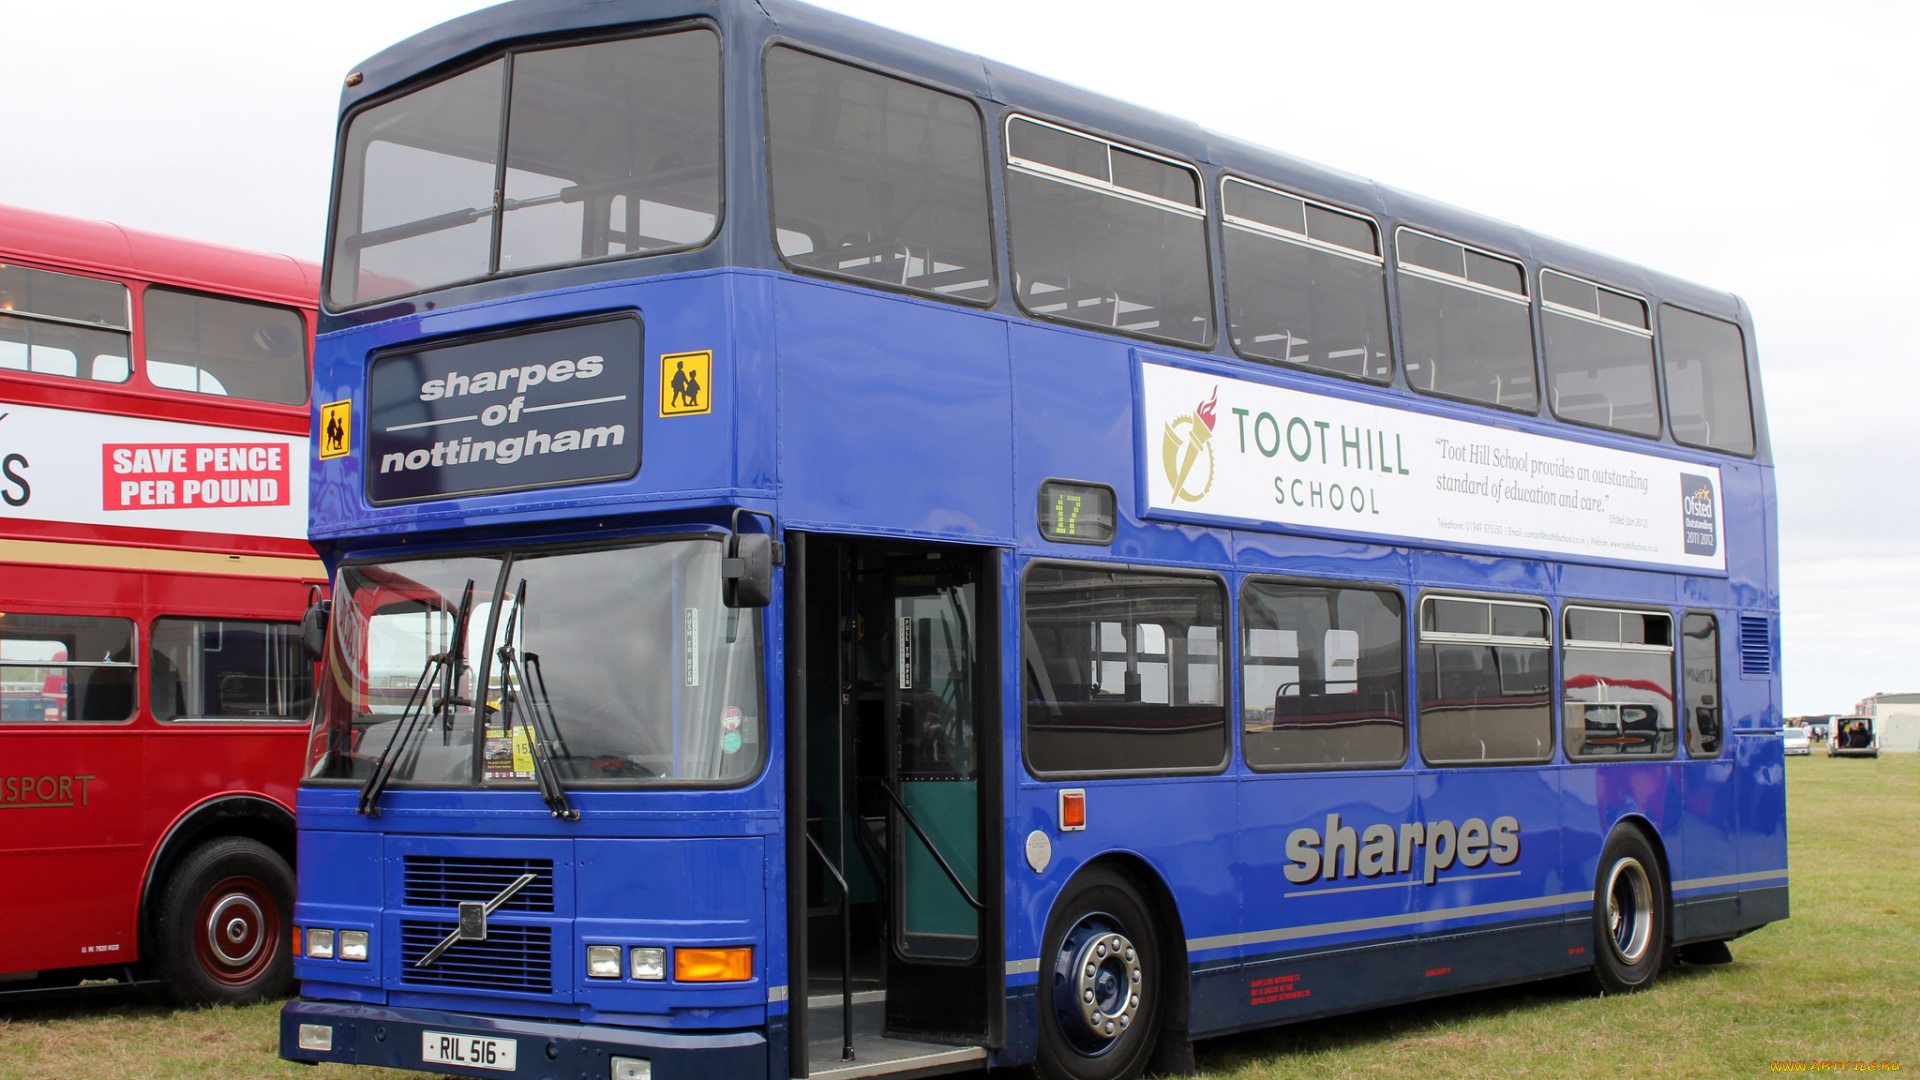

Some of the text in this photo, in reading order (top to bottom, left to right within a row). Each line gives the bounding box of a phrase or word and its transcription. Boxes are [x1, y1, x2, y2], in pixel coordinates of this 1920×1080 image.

[419, 355, 604, 401] sharpes
[481, 396, 525, 427] of
[380, 424, 625, 474] nottingham
[1232, 407, 1409, 475] TOOT HILL
[113, 447, 282, 474] SAVE PENCE
[1469, 444, 1490, 466] Hill
[1492, 447, 1528, 472] School
[1531, 458, 1575, 480] provides
[1577, 467, 1590, 482] an
[1592, 469, 1648, 495] outstanding
[120, 478, 278, 506] PER POUND
[1274, 476, 1379, 514] SCHOOL
[1436, 472, 1488, 497] standard
[1491, 478, 1503, 503] of
[1504, 480, 1556, 507] education
[1559, 489, 1578, 509] and
[1684, 496, 1712, 518] Ofsted
[1056, 494, 1081, 534] 17
[1685, 517, 1713, 533] Outstanding
[1283, 813, 1521, 886] sharpes
[440, 1036, 496, 1064] RIL 516
